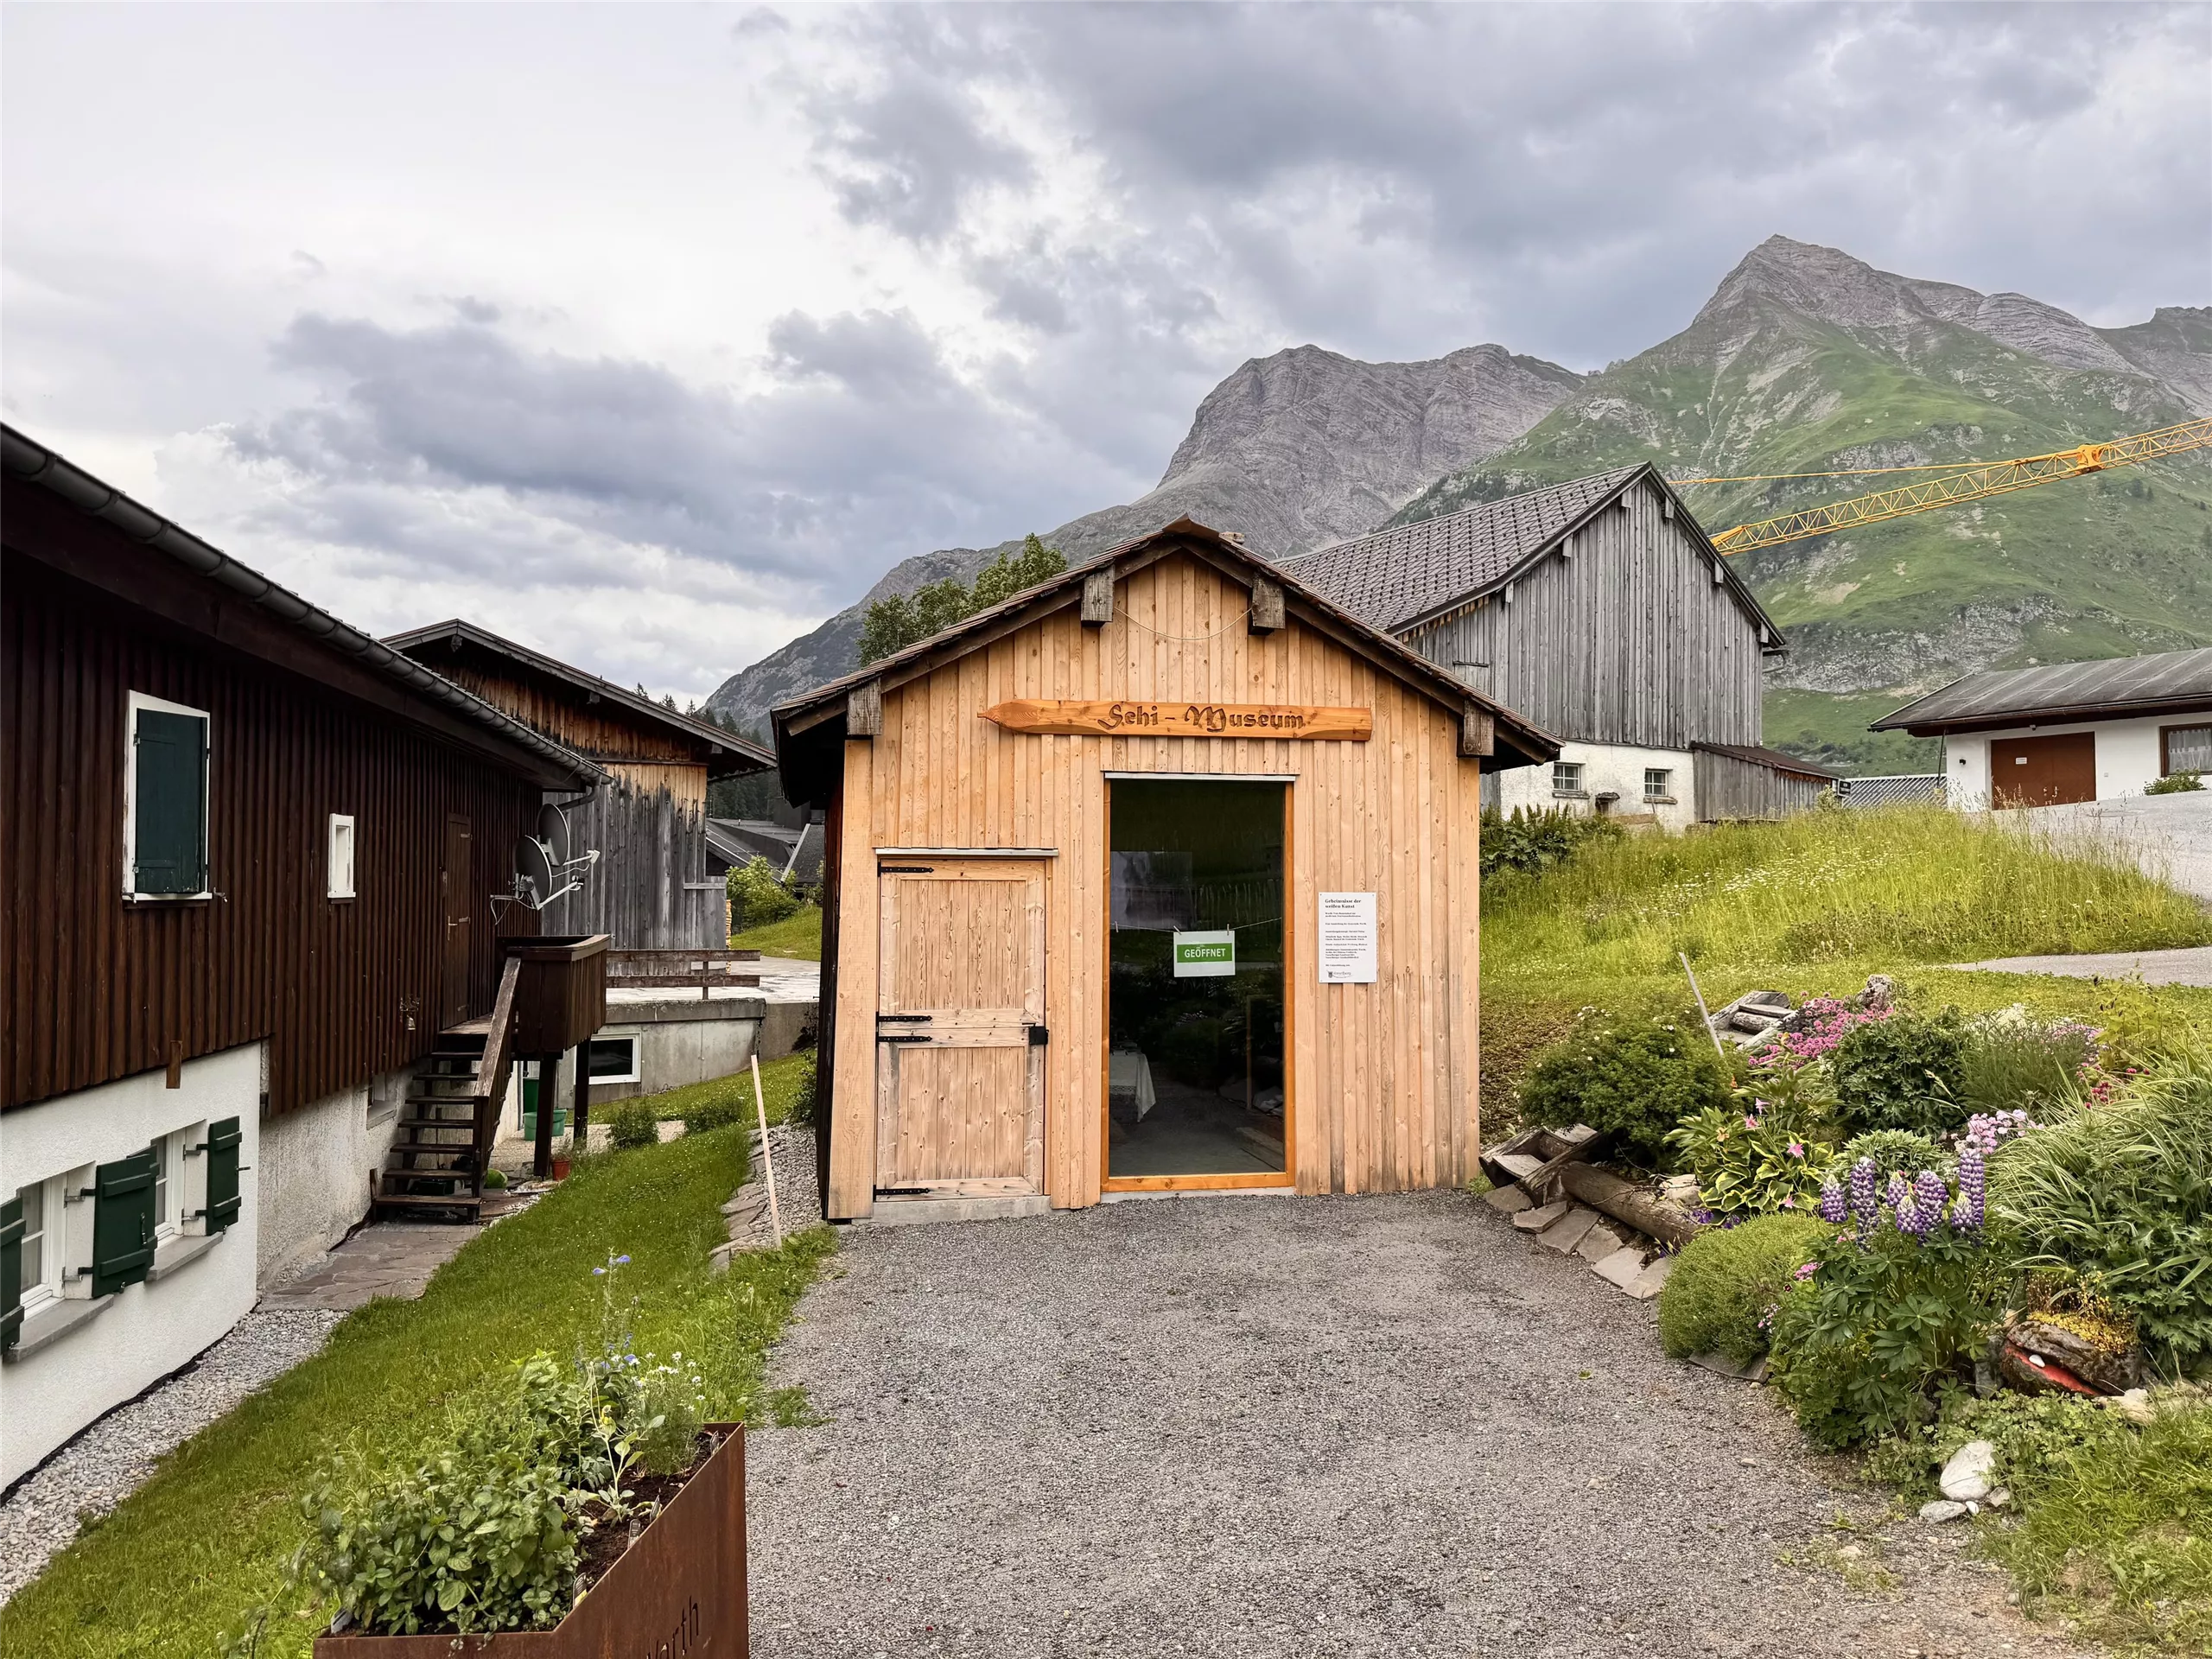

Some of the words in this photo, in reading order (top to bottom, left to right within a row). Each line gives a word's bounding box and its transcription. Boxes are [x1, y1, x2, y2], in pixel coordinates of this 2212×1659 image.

[1097, 703, 1159, 730] Schi
[1184, 705, 1306, 733] Museum
[1184, 946, 1226, 958] GEÖFFNET
